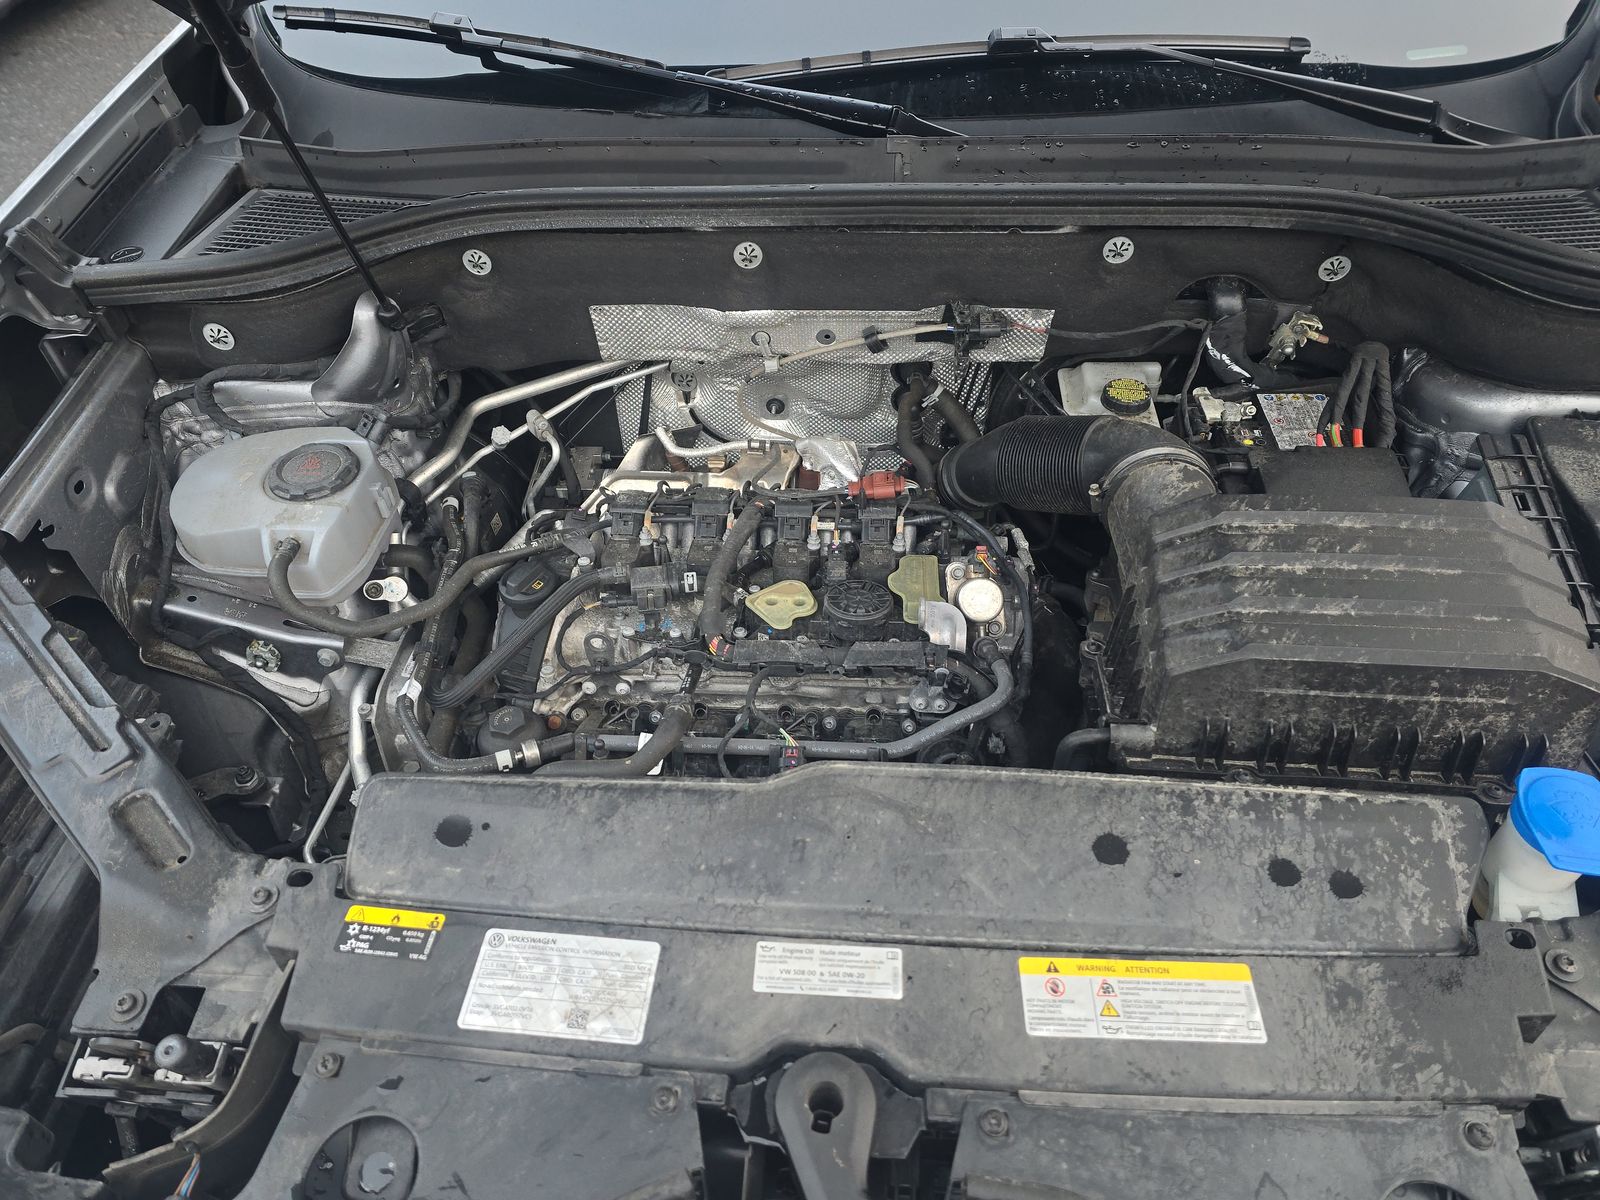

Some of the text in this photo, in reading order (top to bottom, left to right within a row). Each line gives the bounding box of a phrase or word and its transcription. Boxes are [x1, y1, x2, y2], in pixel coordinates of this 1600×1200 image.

[507, 935, 558, 945] VOLKSWAGEN
[582, 949, 621, 957] INFORMATION
[782, 947, 804, 955] Engine
[1076, 964, 1170, 974] WARNING ATTENTION
